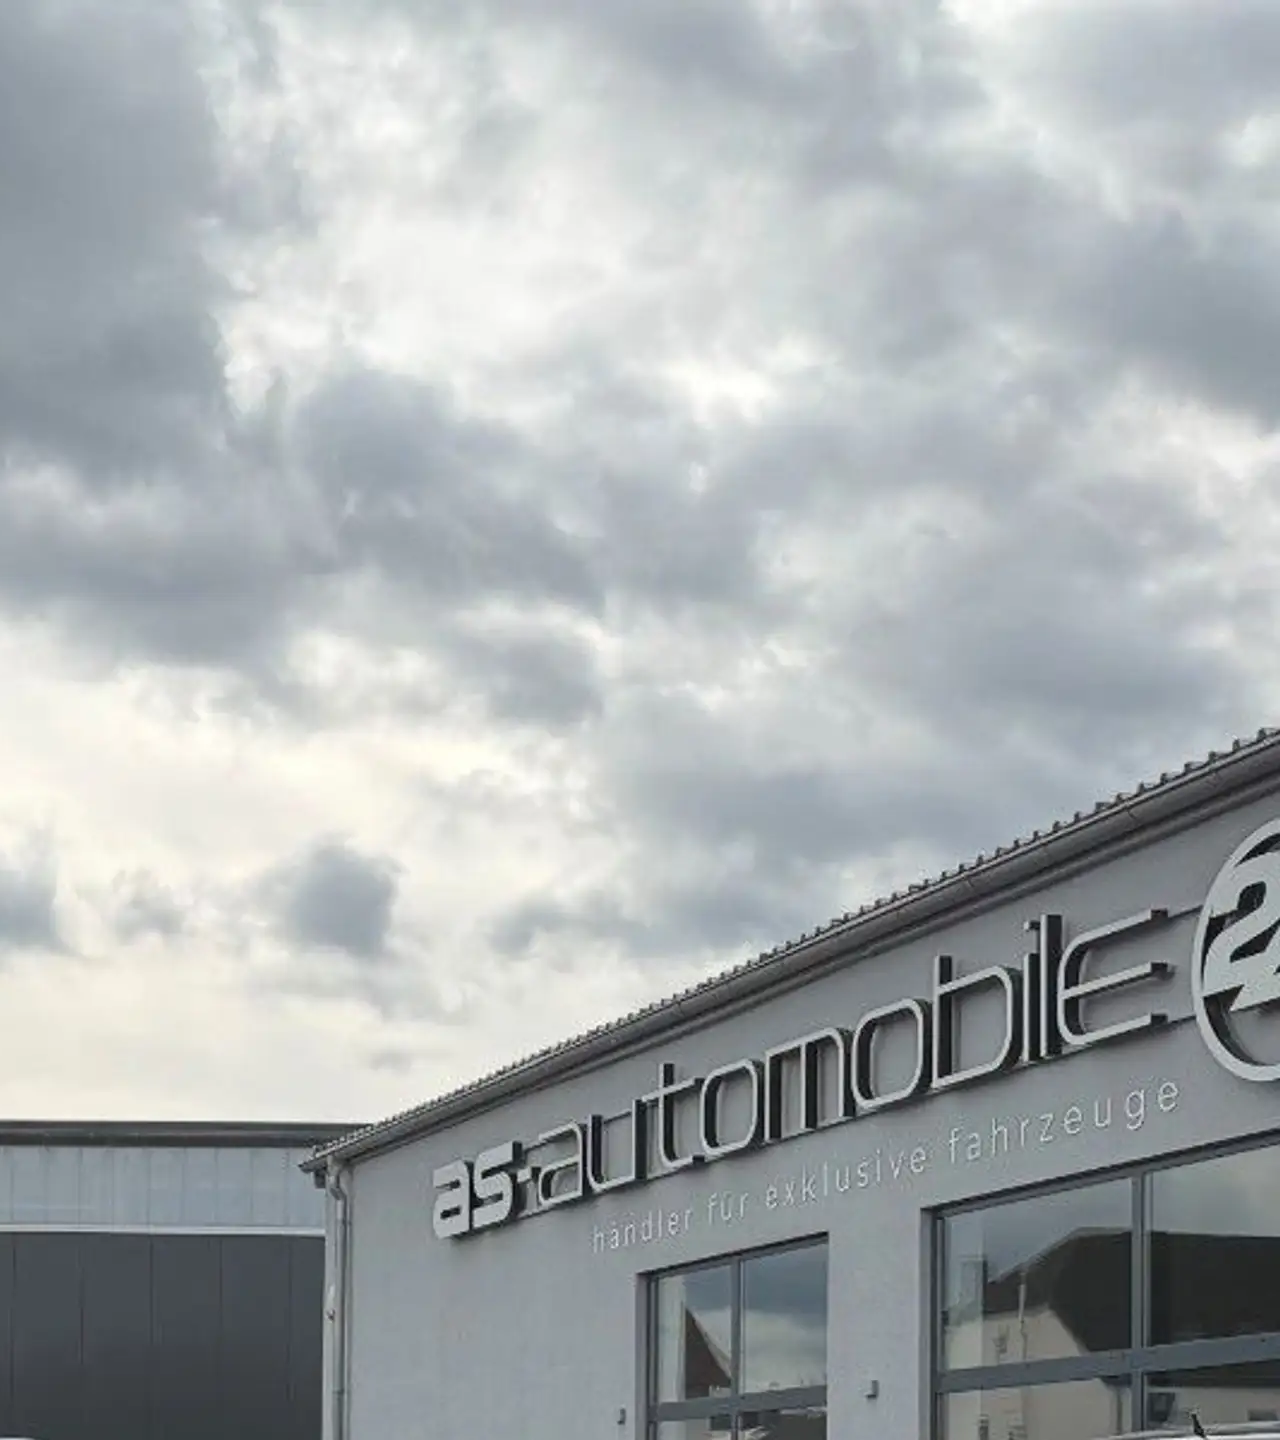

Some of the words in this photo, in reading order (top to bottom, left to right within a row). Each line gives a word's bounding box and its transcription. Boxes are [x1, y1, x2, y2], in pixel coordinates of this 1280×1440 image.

[592, 1208, 692, 1253] händler
[706, 1189, 748, 1225] für
[765, 1146, 927, 1210] exklusive
[948, 1081, 1178, 1164] fahrzeuge
